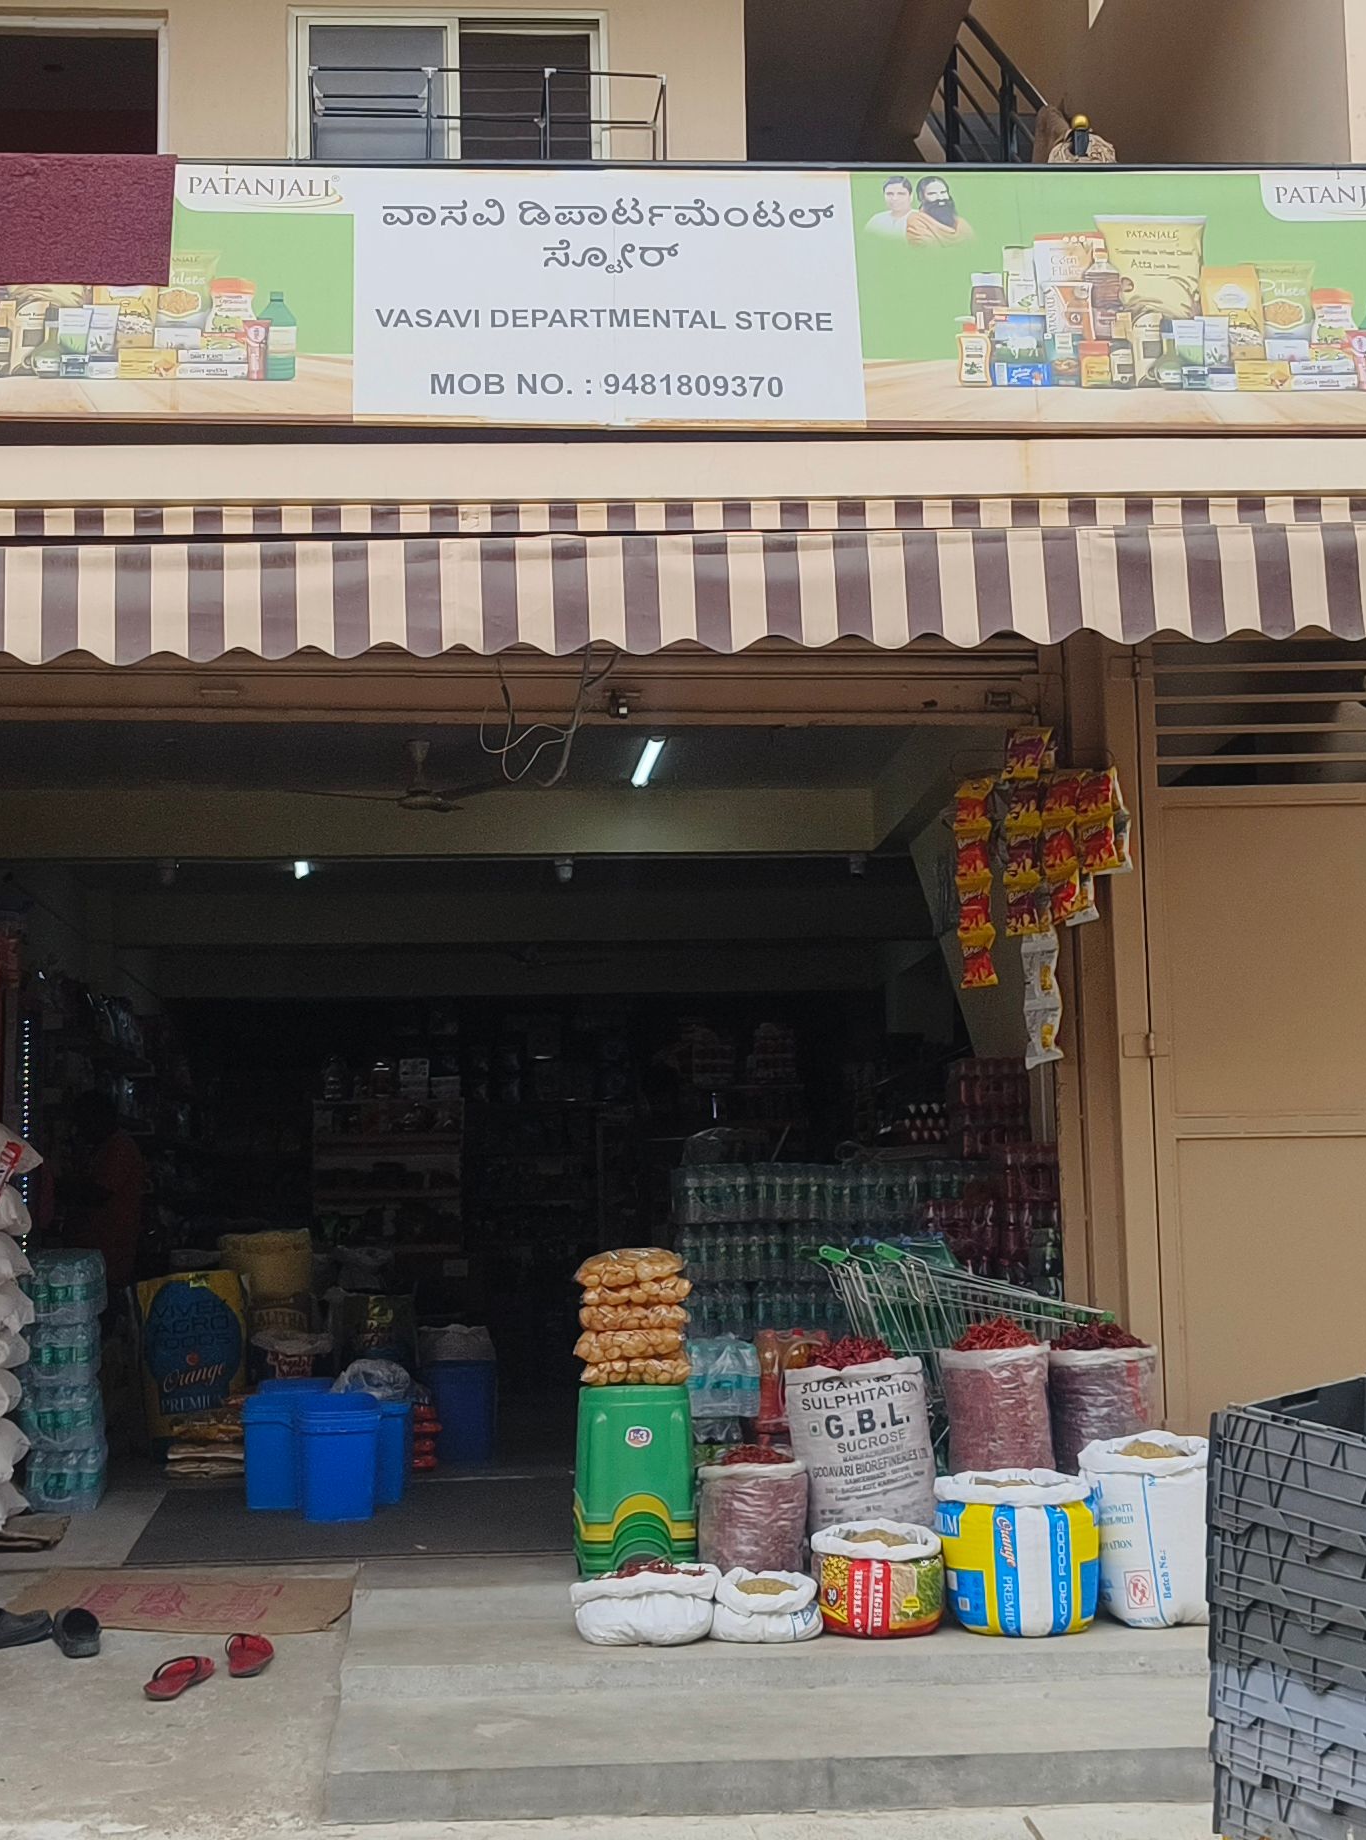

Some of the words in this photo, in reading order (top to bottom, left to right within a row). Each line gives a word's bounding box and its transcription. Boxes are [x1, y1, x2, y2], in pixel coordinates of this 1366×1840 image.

[188, 175, 334, 198] PATANJALI
[382, 198, 505, 227] ವಾಸವಿ
[375, 309, 480, 328] VASAVI
[490, 308, 726, 330] DEPARTMENTAL
[735, 311, 833, 332] STORE
[430, 373, 505, 395] MOB
[516, 373, 574, 395] NO.
[603, 374, 784, 398] 9481809370
[155, 1316, 229, 1334] AGRO
[163, 1364, 225, 1394] Orange
[161, 1395, 223, 1414] PREMIU
[801, 1380, 919, 1411] SULPHITATION
[825, 1402, 911, 1440] G.B.L.
[837, 1428, 907, 1454] SUCROSE
[812, 1463, 854, 1479] GODAVARI
[996, 1516, 1017, 1568] Orange
[1057, 1520, 1066, 1577] FOODS
[873, 1582, 884, 1628] TIGER
[1059, 1581, 1068, 1626] AGRO
